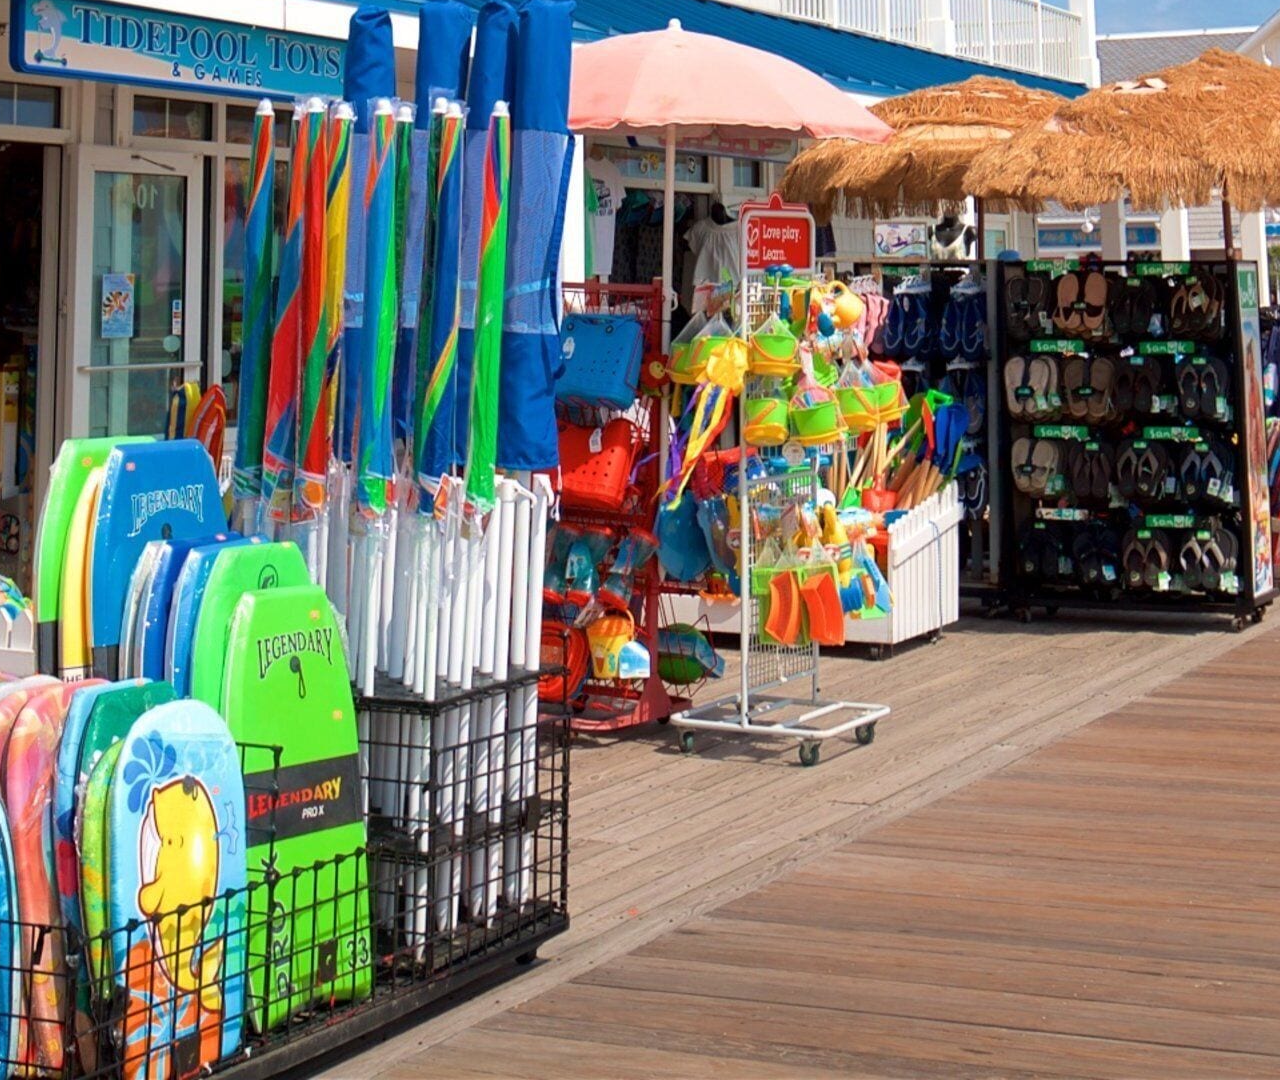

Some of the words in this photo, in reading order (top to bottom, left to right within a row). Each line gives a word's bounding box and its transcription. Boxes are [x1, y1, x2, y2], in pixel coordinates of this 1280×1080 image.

[73, 5, 258, 67] TIDEPOOL
[267, 34, 342, 78] TOYS
[171, 63, 182, 78] &
[194, 64, 263, 88] GAMES
[763, 224, 780, 240] Love
[782, 225, 801, 243] play.
[763, 246, 787, 261] Learn.
[127, 483, 204, 537] LEGENDARY
[257, 627, 333, 680] LEGENDARY
[302, 806, 318, 819] PRO
[318, 805, 325, 816] X
